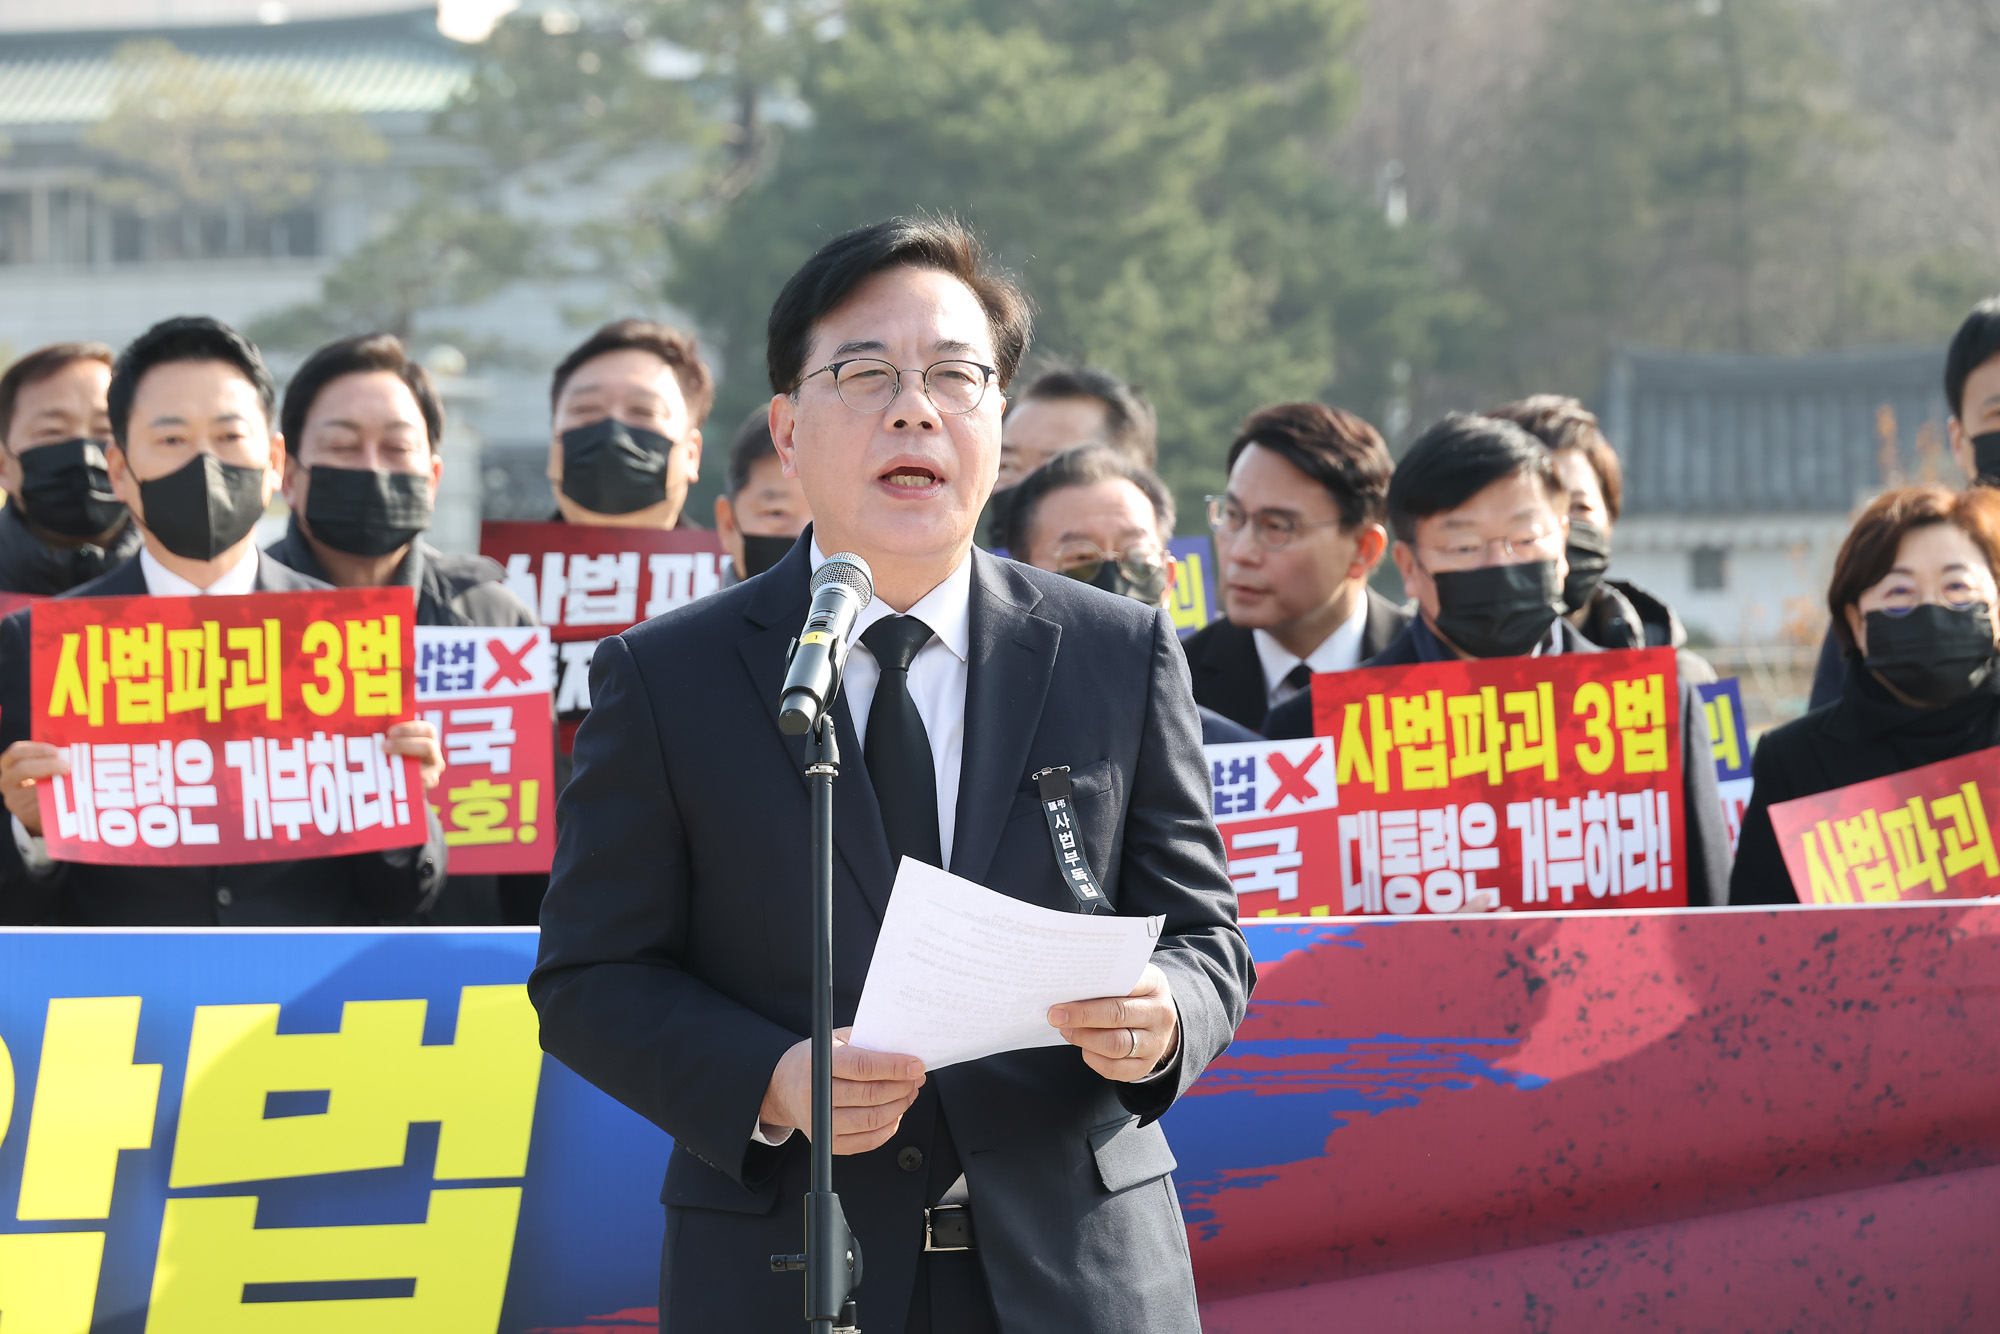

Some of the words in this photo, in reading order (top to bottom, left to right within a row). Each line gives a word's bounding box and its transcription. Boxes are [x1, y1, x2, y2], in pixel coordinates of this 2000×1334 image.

[502, 552, 734, 626] 사법파
[48, 618, 282, 726] 사법파괴
[301, 615, 402, 717] 3법
[424, 706, 516, 774] 국
[1213, 756, 1256, 815] 법
[1336, 681, 1559, 793] 사법파괴
[1573, 674, 1668, 774] 3법
[52, 739, 220, 848] 대통령은
[225, 731, 410, 841] 거부하라!
[431, 779, 539, 842] 호!
[1802, 781, 2000, 904] 사법파괴
[1338, 802, 1500, 913] 대통령은
[1507, 788, 1671, 903] 거부하라!
